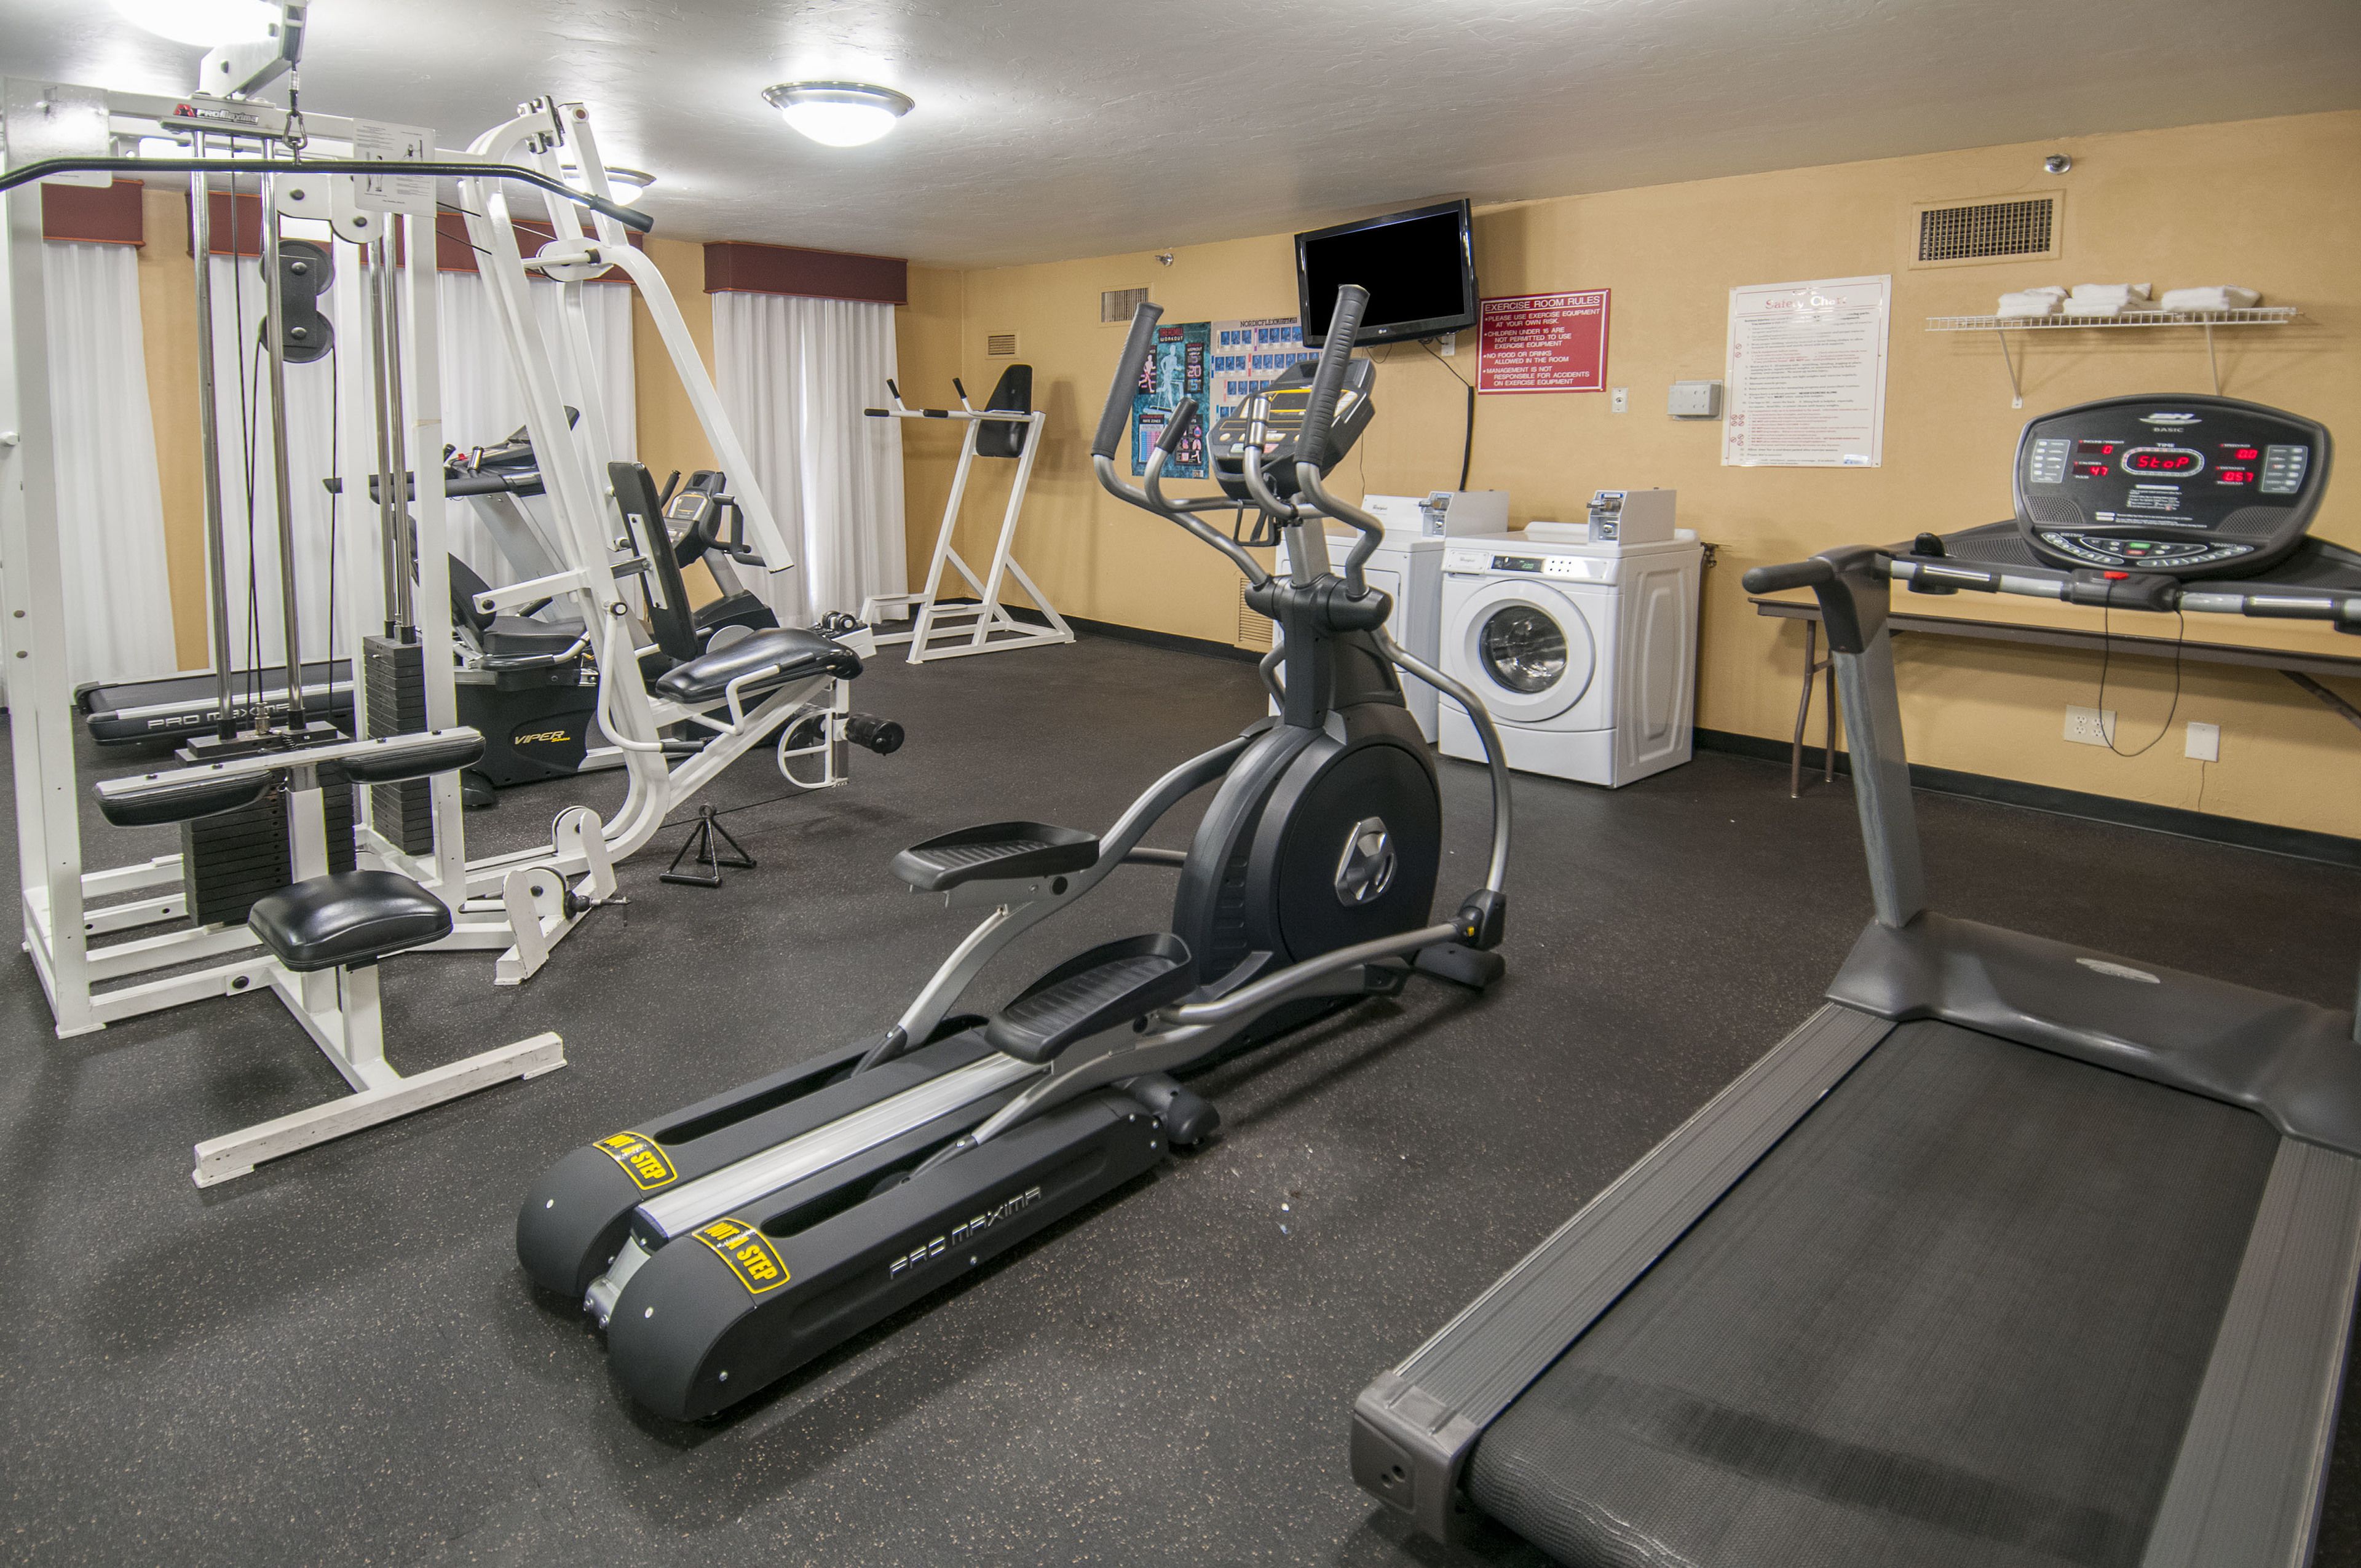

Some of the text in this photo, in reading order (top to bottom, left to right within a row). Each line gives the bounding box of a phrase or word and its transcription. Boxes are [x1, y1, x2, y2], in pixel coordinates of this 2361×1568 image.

[1485, 296, 1600, 312] EXERCISE ROOM RULES
[1562, 309, 1600, 317] EQUIPMENT
[2090, 465, 2109, 477] 47
[147, 714, 200, 730] PRO
[515, 730, 565, 745] VIPER
[604, 1134, 636, 1149] NOT
[630, 1150, 667, 1179] STEP
[704, 1222, 778, 1280] NOT A STEP
[890, 1235, 946, 1280] PRO
